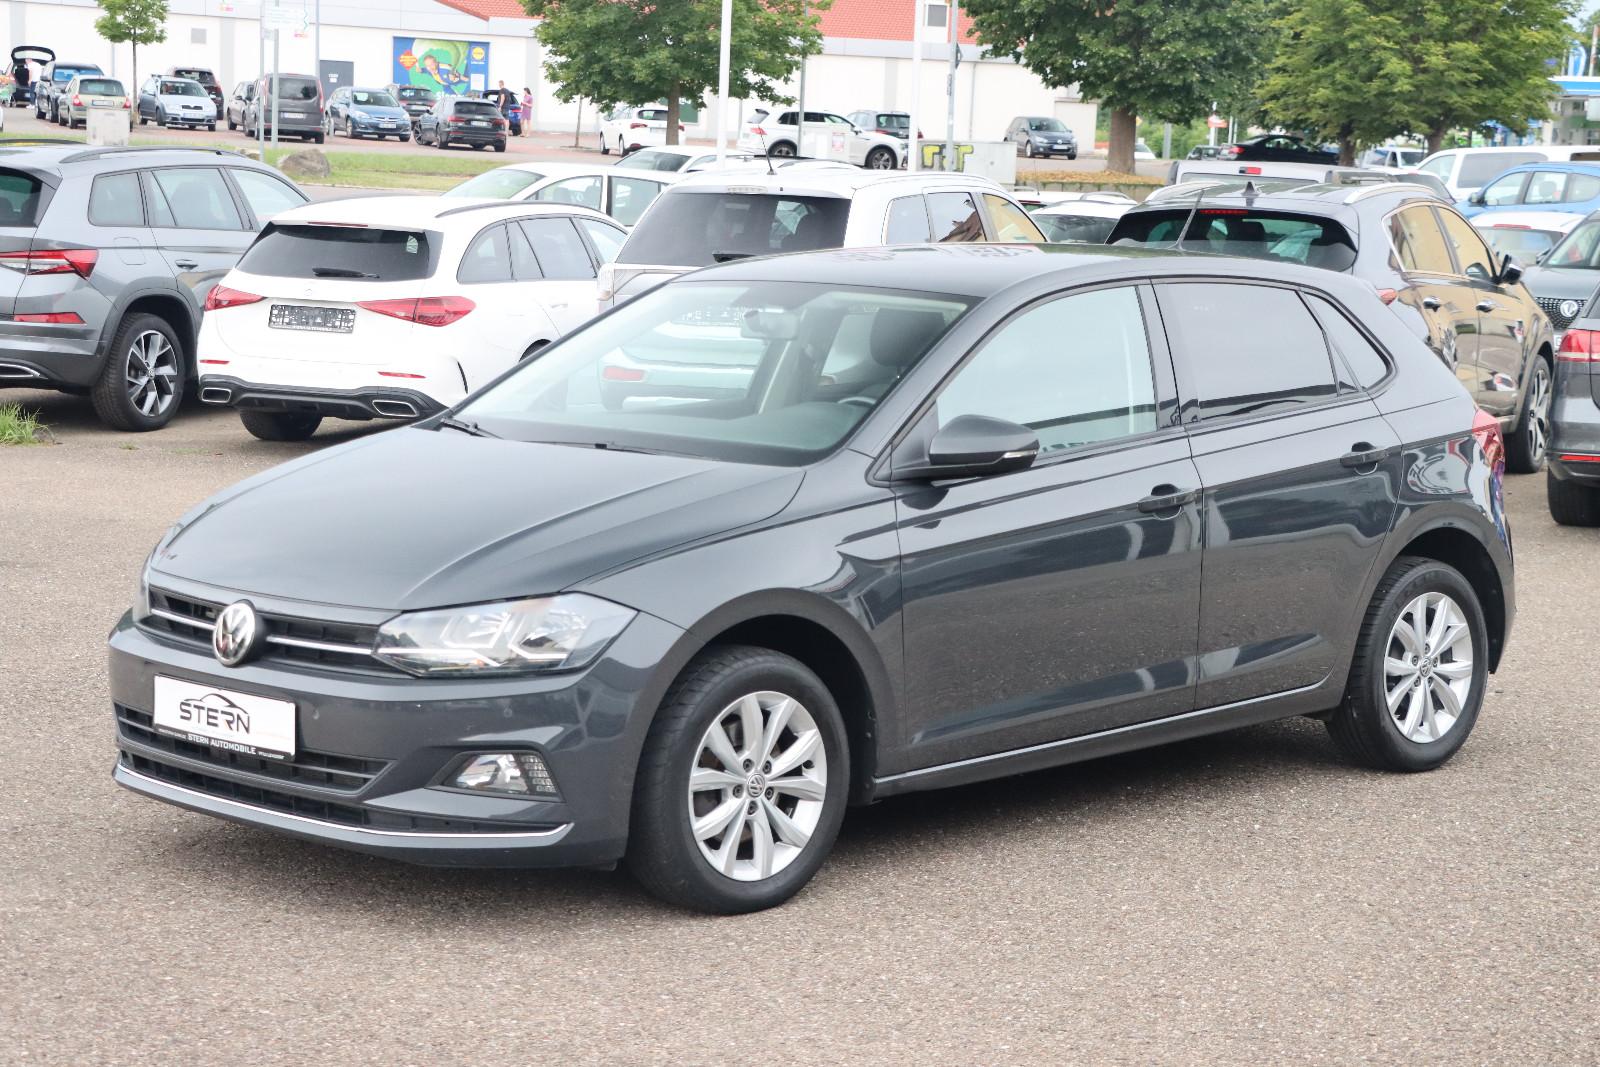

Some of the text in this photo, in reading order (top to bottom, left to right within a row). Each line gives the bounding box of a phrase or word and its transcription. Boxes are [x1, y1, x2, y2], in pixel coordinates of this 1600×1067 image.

[179, 701, 250, 734] STERN
[187, 733, 210, 745] STERN
[210, 738, 257, 755] AUTOMOBILE
